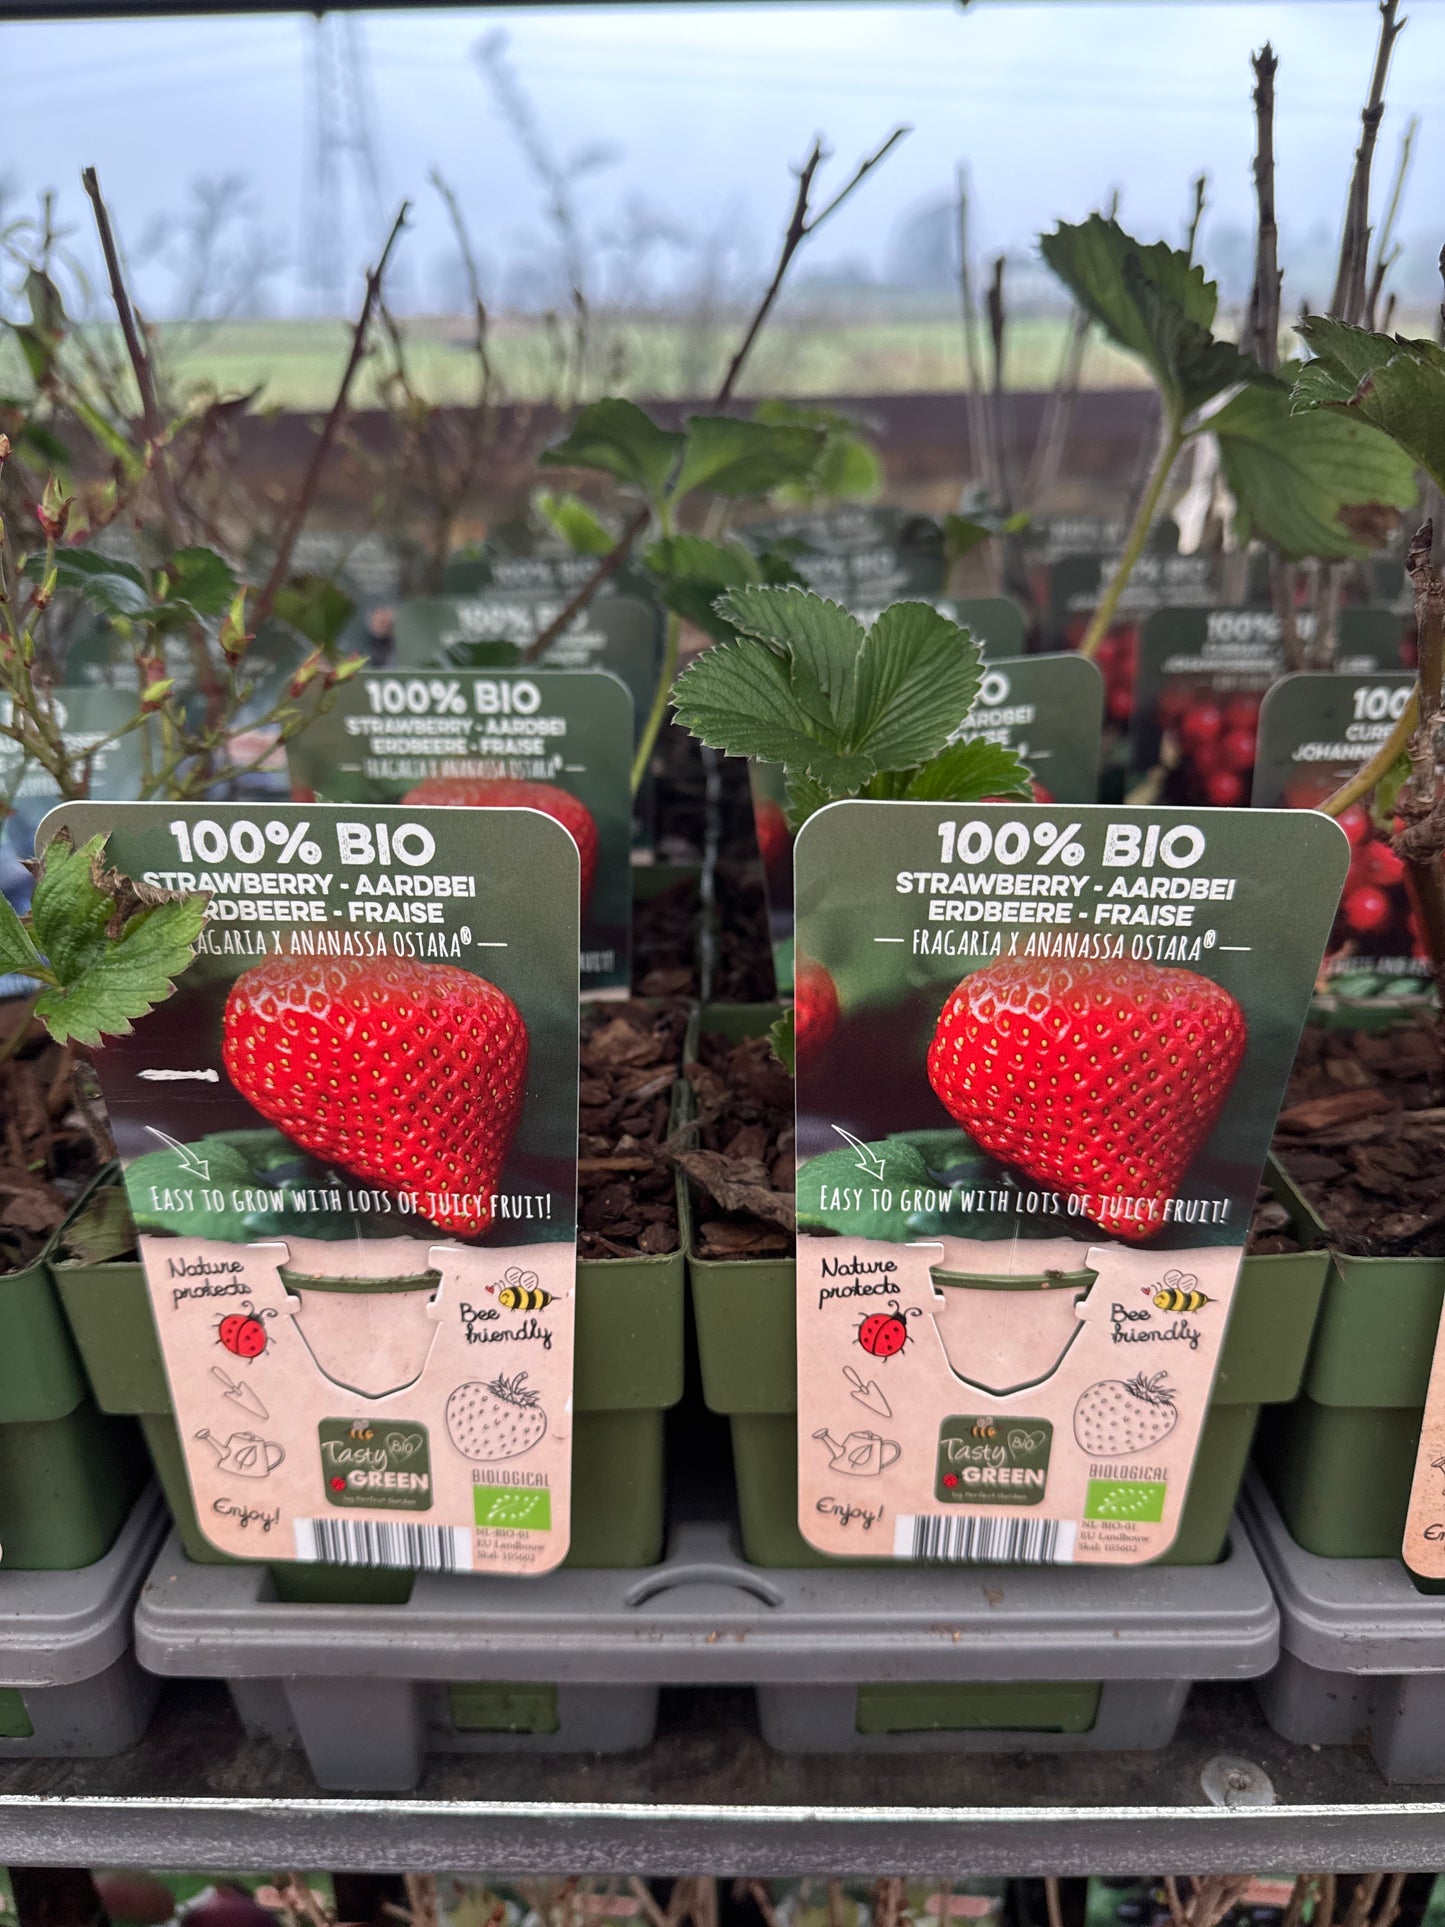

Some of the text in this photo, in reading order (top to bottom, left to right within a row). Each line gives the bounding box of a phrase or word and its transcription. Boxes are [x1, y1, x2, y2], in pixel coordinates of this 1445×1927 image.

[365, 679, 541, 715] 100% BIO
[1353, 686, 1412, 720] 100
[345, 715, 474, 735] STRAWBERRY
[962, 704, 1035, 729] ARDBEI
[170, 820, 436, 867] 100% BIO
[938, 821, 1205, 869] 100% BIO
[143, 872, 333, 895] STRAWBERRY
[355, 875, 476, 897] AARDBEI
[896, 872, 1090, 897] STRAWBERRY
[1107, 876, 1236, 900] AARDBEI
[203, 900, 327, 922] RDBEERE
[350, 902, 444, 923] FRAISE
[928, 900, 1072, 924] ERDBEERE
[1094, 903, 1195, 927] FRAISE
[189, 929, 267, 955] AGARIA
[272, 930, 283, 955] X
[290, 930, 387, 957] ANANASSA
[912, 929, 1001, 957] FRAGARIA
[1008, 931, 1018, 956] X
[1024, 931, 1124, 960] ANANASSA
[201, 1188, 224, 1213] TO
[233, 1188, 284, 1213] GROW
[291, 1188, 342, 1213] WITH
[348, 1189, 392, 1214] LOTS
[398, 1191, 418, 1215] OF
[427, 1192, 483, 1218] JUICY
[490, 1192, 552, 1220] FRUIT!
[871, 1188, 893, 1212] TO
[901, 1188, 954, 1212] GROW
[960, 1188, 1012, 1213] WITH
[1016, 1191, 1061, 1215] LOTS
[1068, 1194, 1091, 1217] OF
[1097, 1194, 1158, 1222] JUICY
[1162, 1197, 1231, 1226] FRUIT!
[168, 1257, 245, 1278] Nature
[821, 1257, 898, 1279] Nature
[173, 1281, 252, 1309] protects
[819, 1277, 901, 1309] protects
[460, 1302, 500, 1322] Bee
[1110, 1303, 1152, 1322] Bee
[464, 1319, 552, 1350] friendly
[1110, 1319, 1201, 1350] friendly
[321, 1440, 388, 1472] Tasty
[940, 1436, 1034, 1469] Tasty BIO
[347, 1469, 429, 1490] GREEN
[472, 1469, 550, 1487] BIOLOGICAL
[961, 1466, 1044, 1485] GREEN
[1089, 1464, 1168, 1480] BIOLOGICAL
[213, 1497, 280, 1532] Enjoy!
[816, 1496, 884, 1529] Enjoy!
